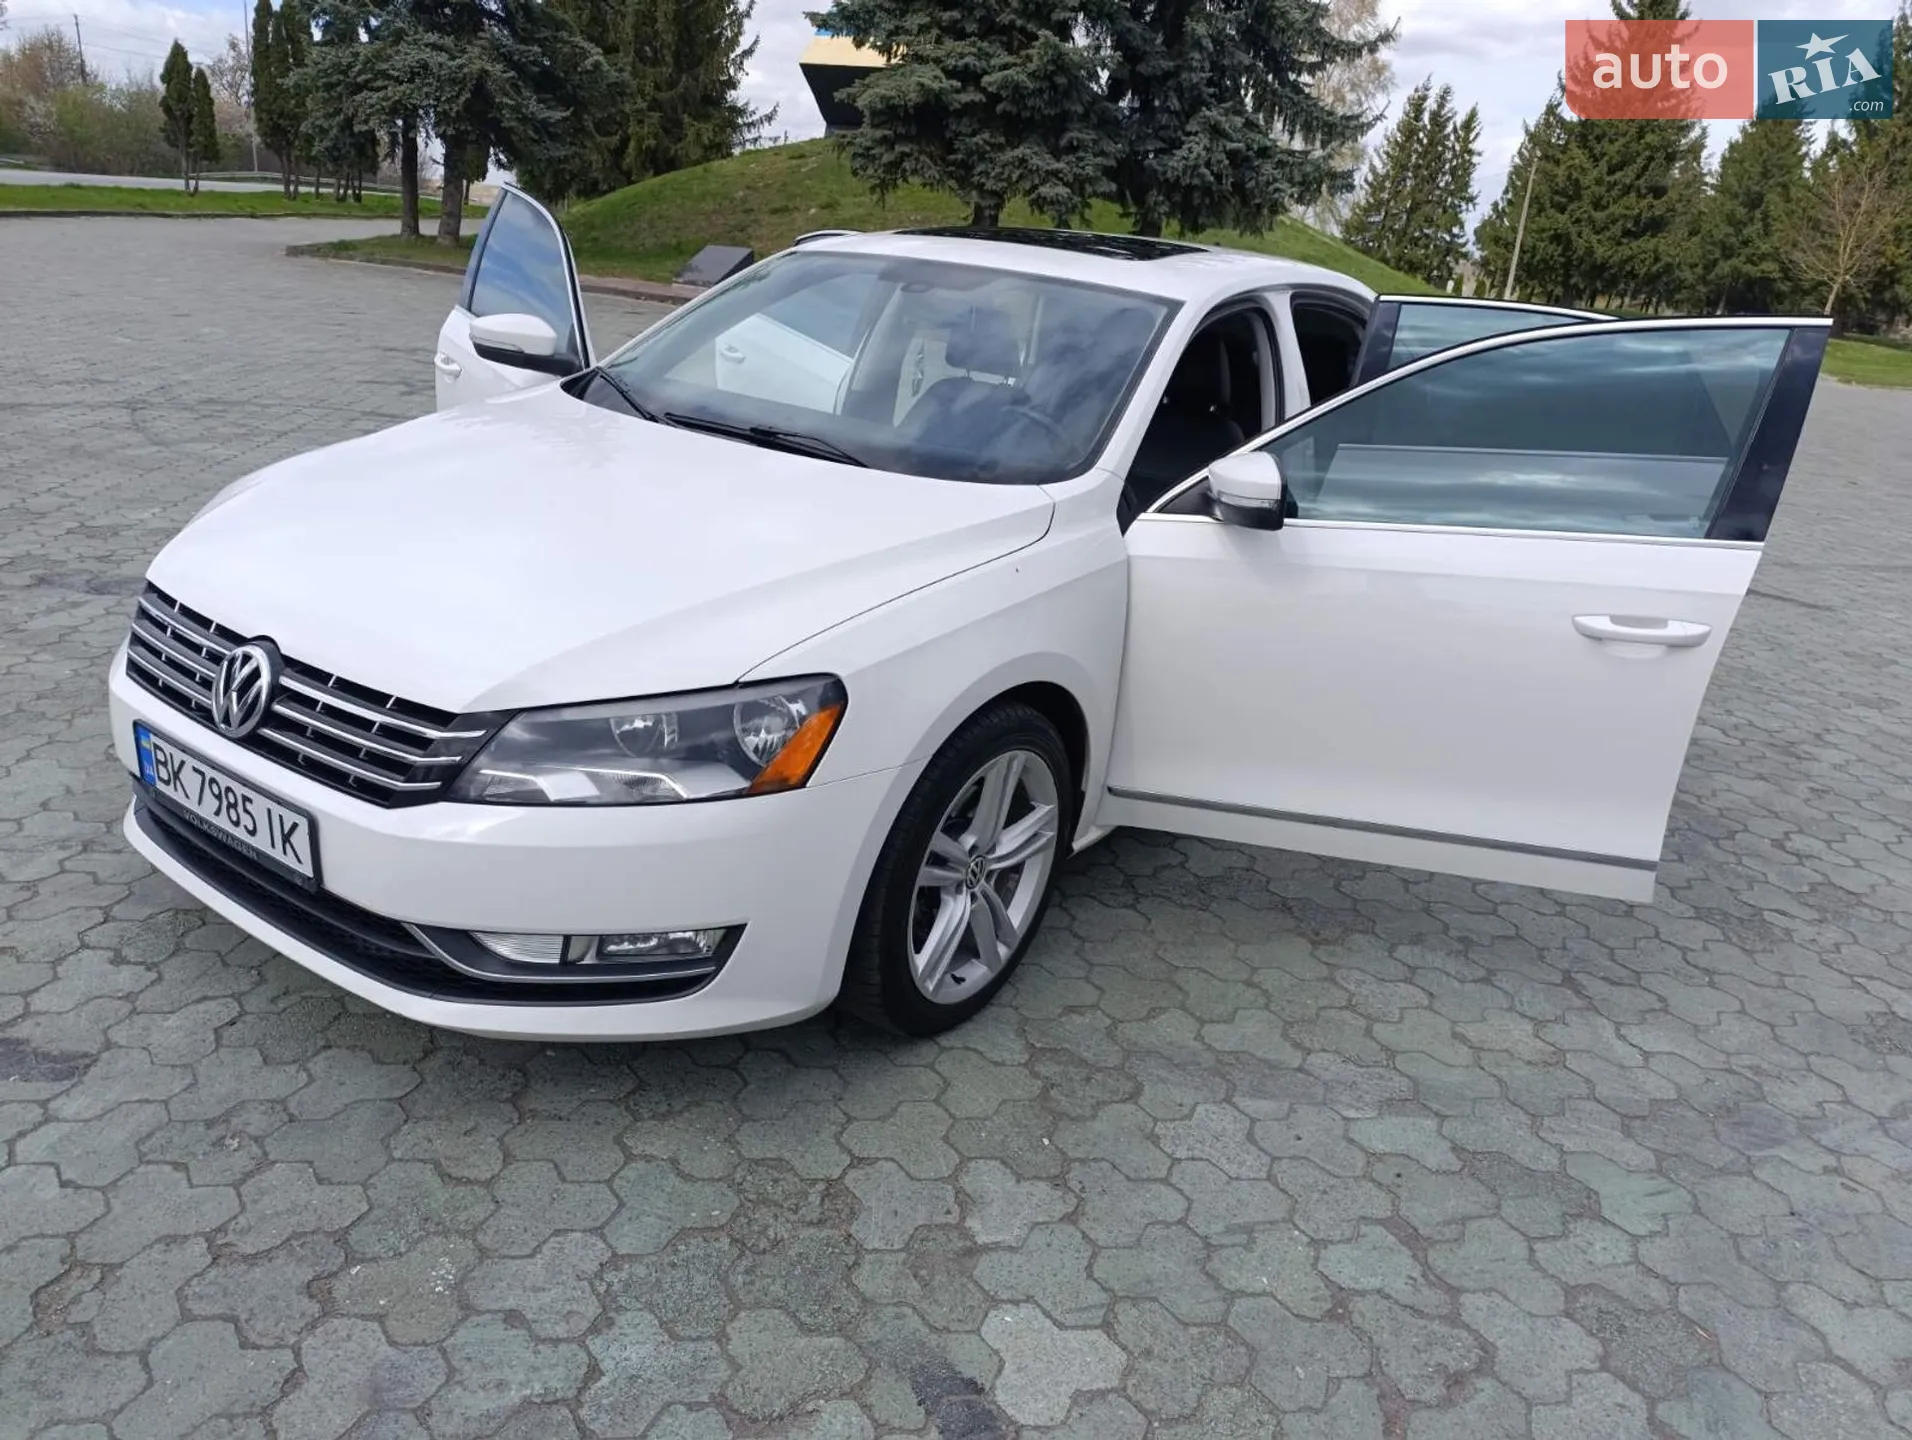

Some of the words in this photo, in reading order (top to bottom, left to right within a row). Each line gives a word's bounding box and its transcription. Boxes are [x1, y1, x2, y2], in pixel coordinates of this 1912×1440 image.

[153, 741, 190, 800] BK
[192, 766, 258, 838] 7985
[266, 807, 304, 865] IK
